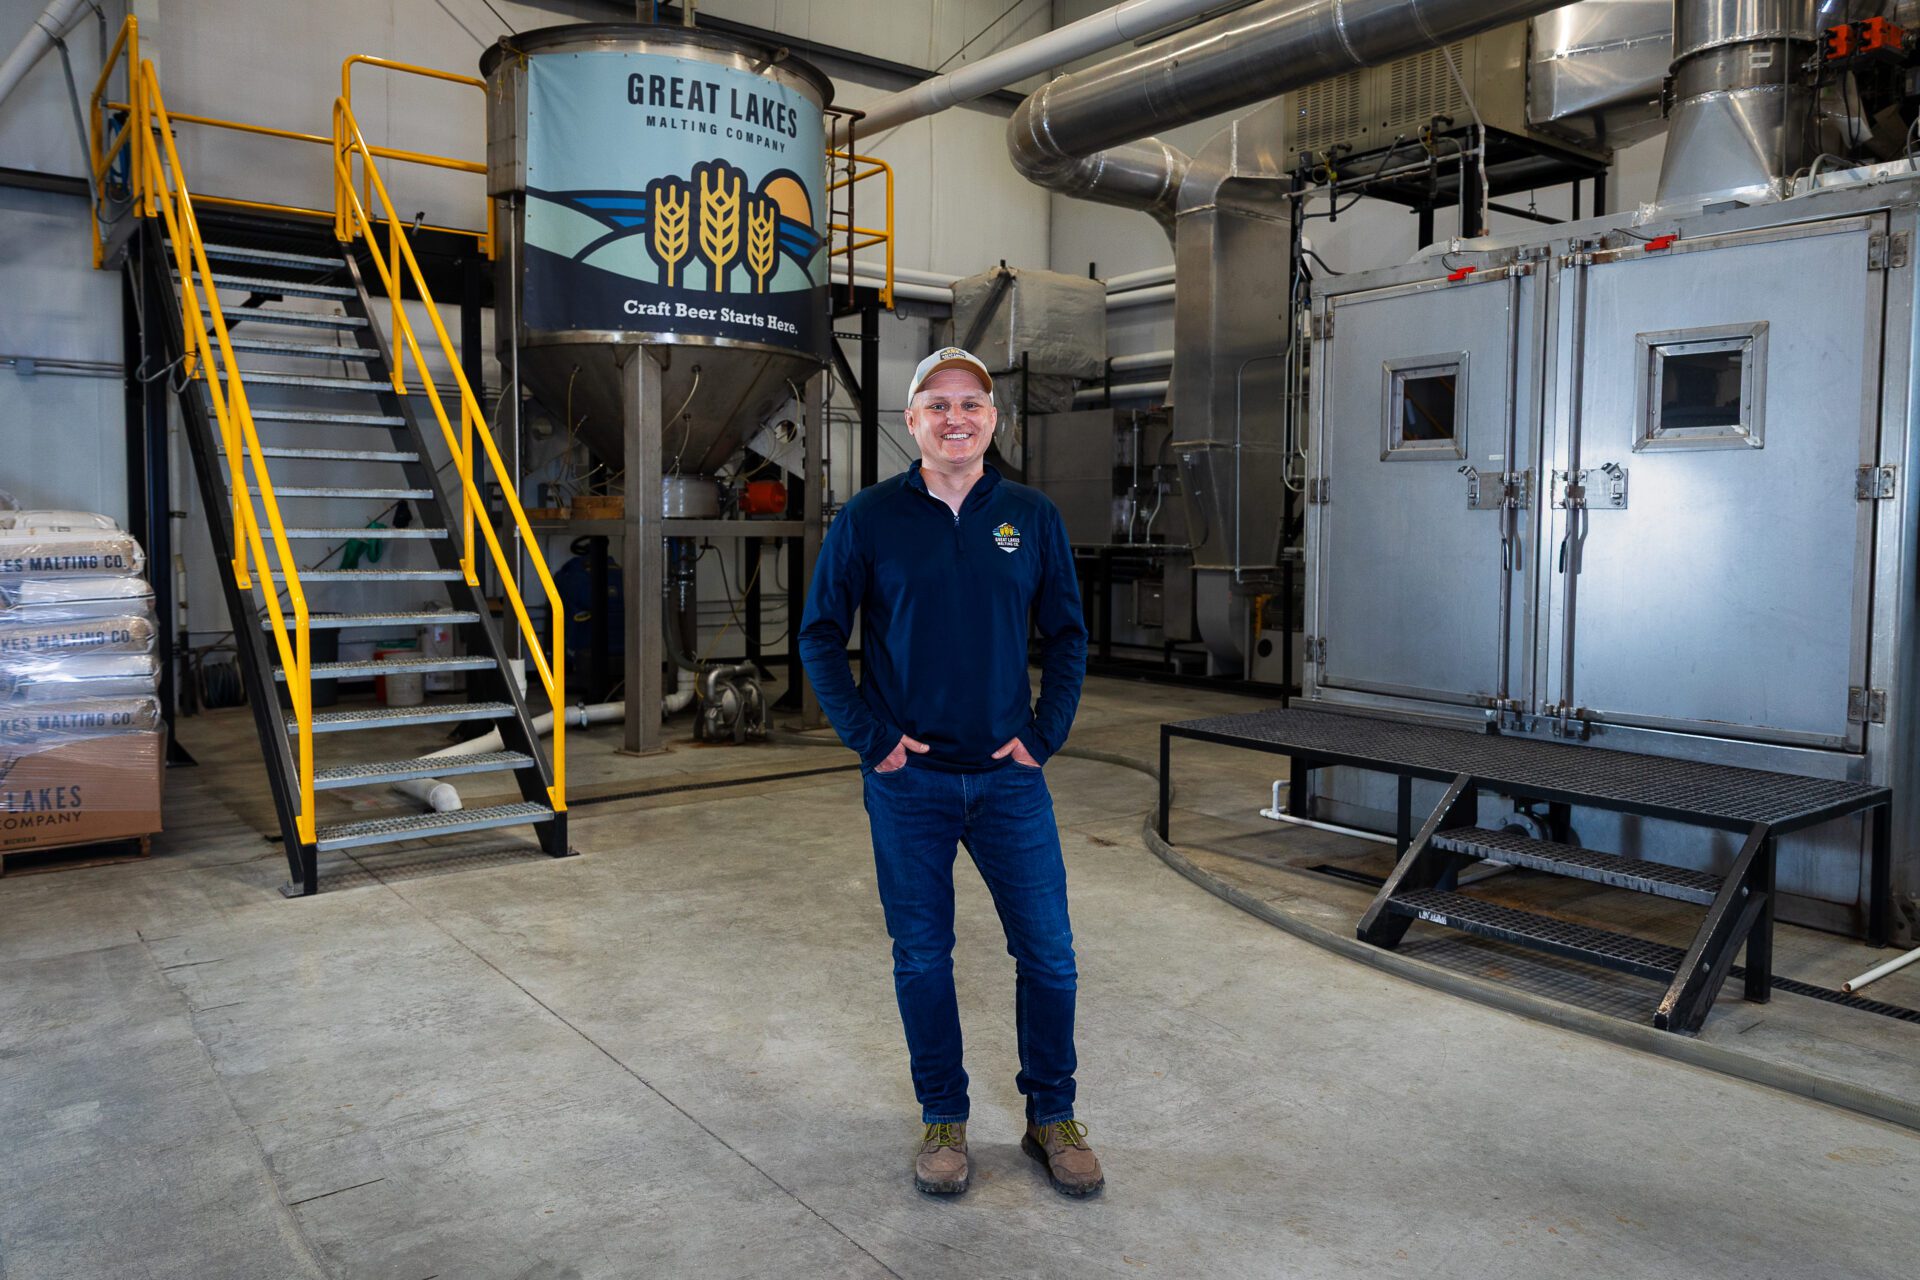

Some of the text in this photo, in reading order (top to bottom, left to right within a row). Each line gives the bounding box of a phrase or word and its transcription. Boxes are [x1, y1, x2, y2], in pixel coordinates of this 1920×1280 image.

[628, 73, 798, 139] GREAT LAKES
[646, 115, 786, 153] MALTING COMPANY
[623, 299, 798, 335] Craft Beer Starts Here.
[0, 554, 127, 573] ES MALTING CO.
[37, 631, 105, 649] MALTING
[111, 629, 135, 644] CO.
[37, 712, 105, 730] MALTING
[111, 712, 135, 725] CO.
[7, 784, 82, 814] LAKES
[0, 810, 82, 830] OMPANY
